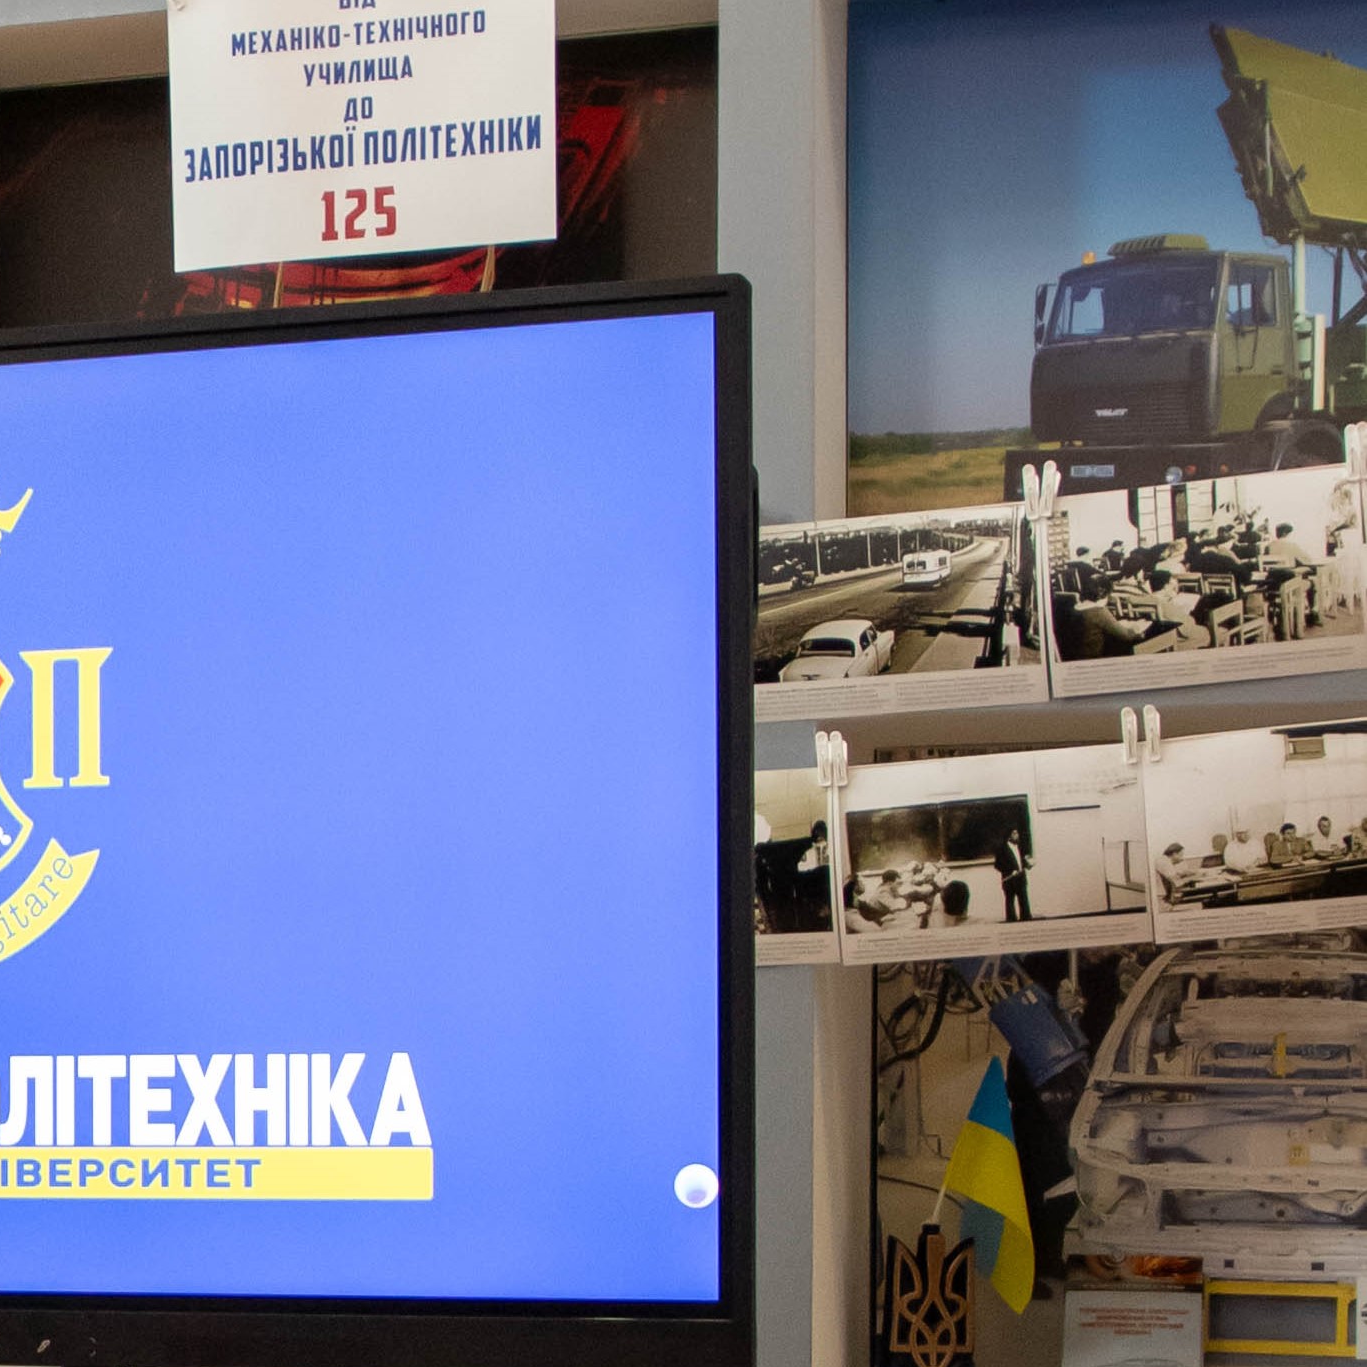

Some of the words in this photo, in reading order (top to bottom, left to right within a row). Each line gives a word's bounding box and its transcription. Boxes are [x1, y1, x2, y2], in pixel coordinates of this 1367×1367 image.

[231, 10, 486, 56] МЕХАНІКО-ТЕХНІЧНОГО
[304, 55, 413, 86] УЧИЛИЩА
[343, 97, 374, 123] ДО
[184, 126, 355, 183] ЗАПОРІЗЬКОЇ
[364, 114, 542, 166] ПОЛІТЕХНІКИ
[321, 185, 397, 241] 125
